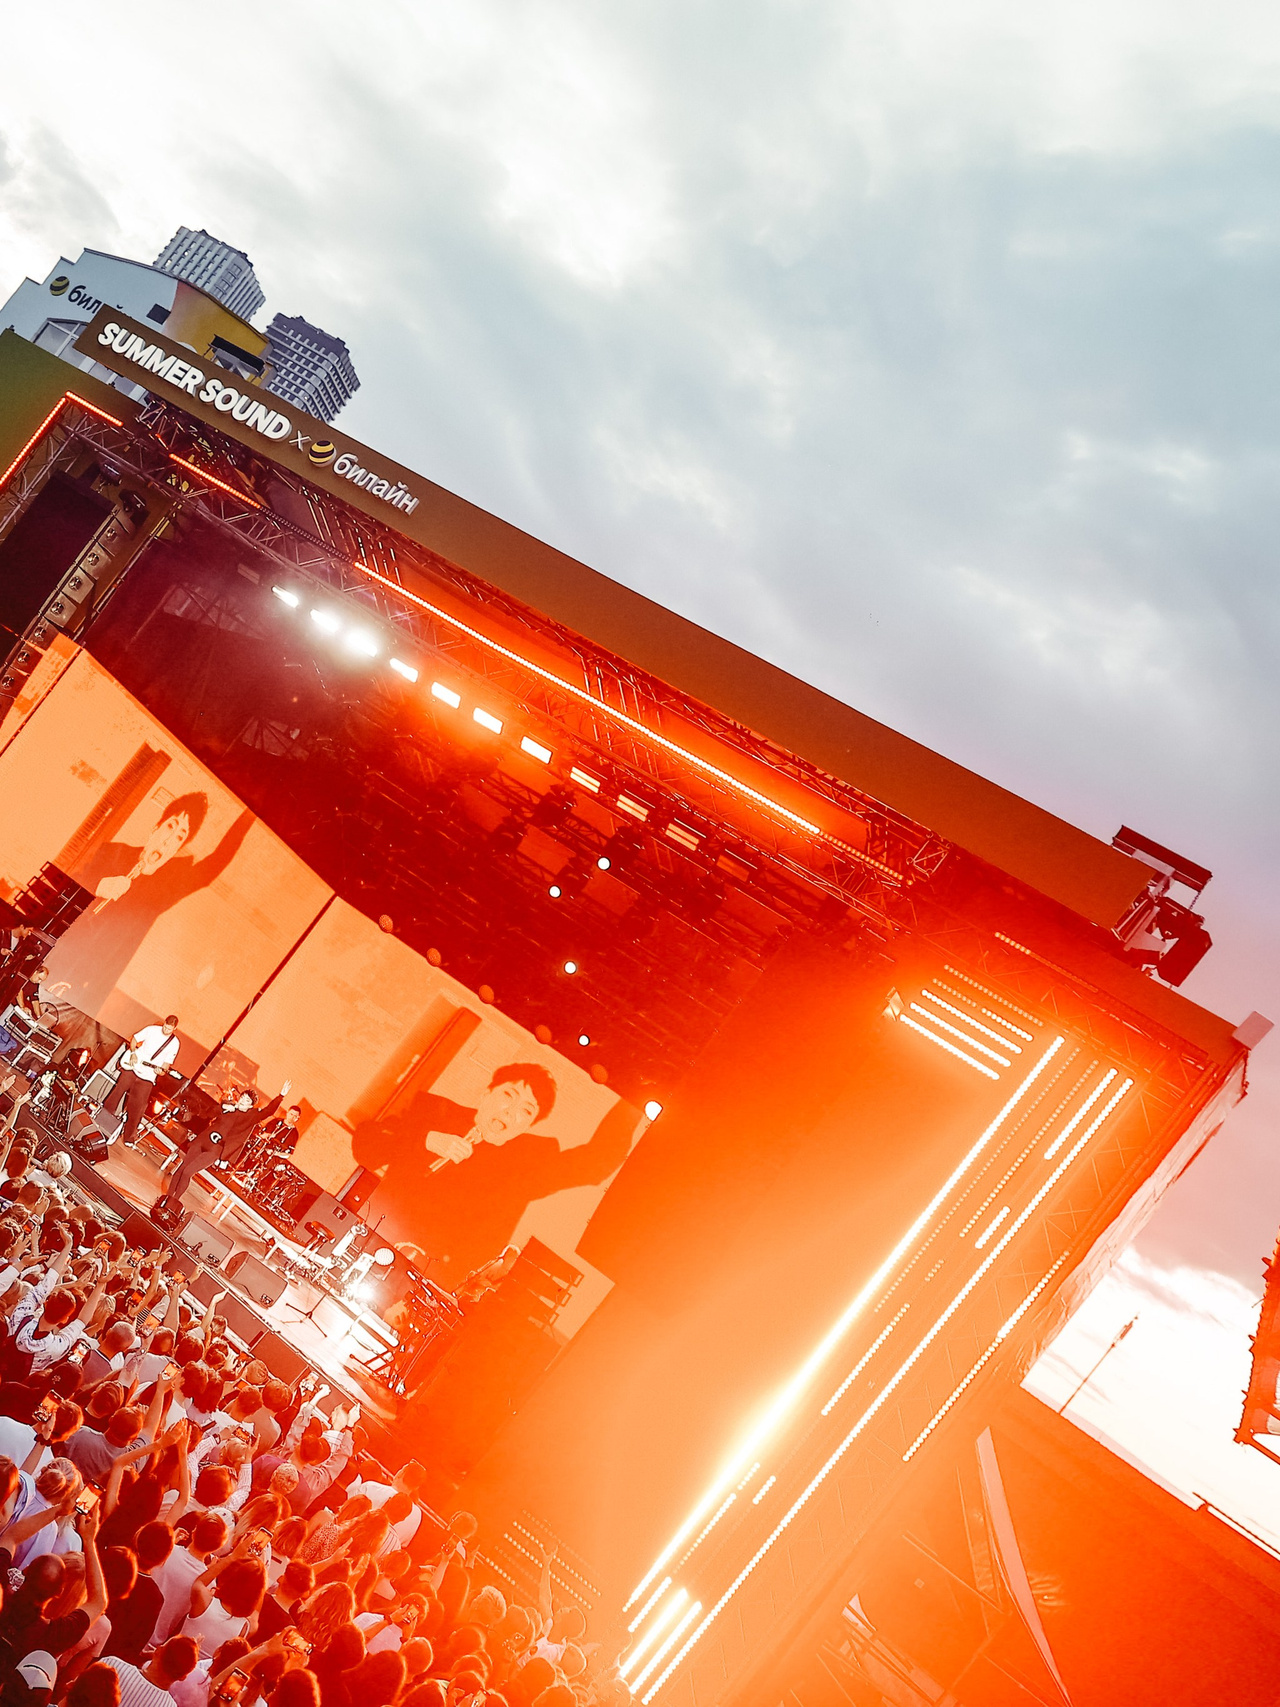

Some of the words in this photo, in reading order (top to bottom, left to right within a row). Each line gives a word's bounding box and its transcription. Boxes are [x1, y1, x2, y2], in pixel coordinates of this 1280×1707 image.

[97, 322, 206, 396] SUMMER
[199, 378, 293, 442] SOUND
[333, 453, 420, 517] билайн
